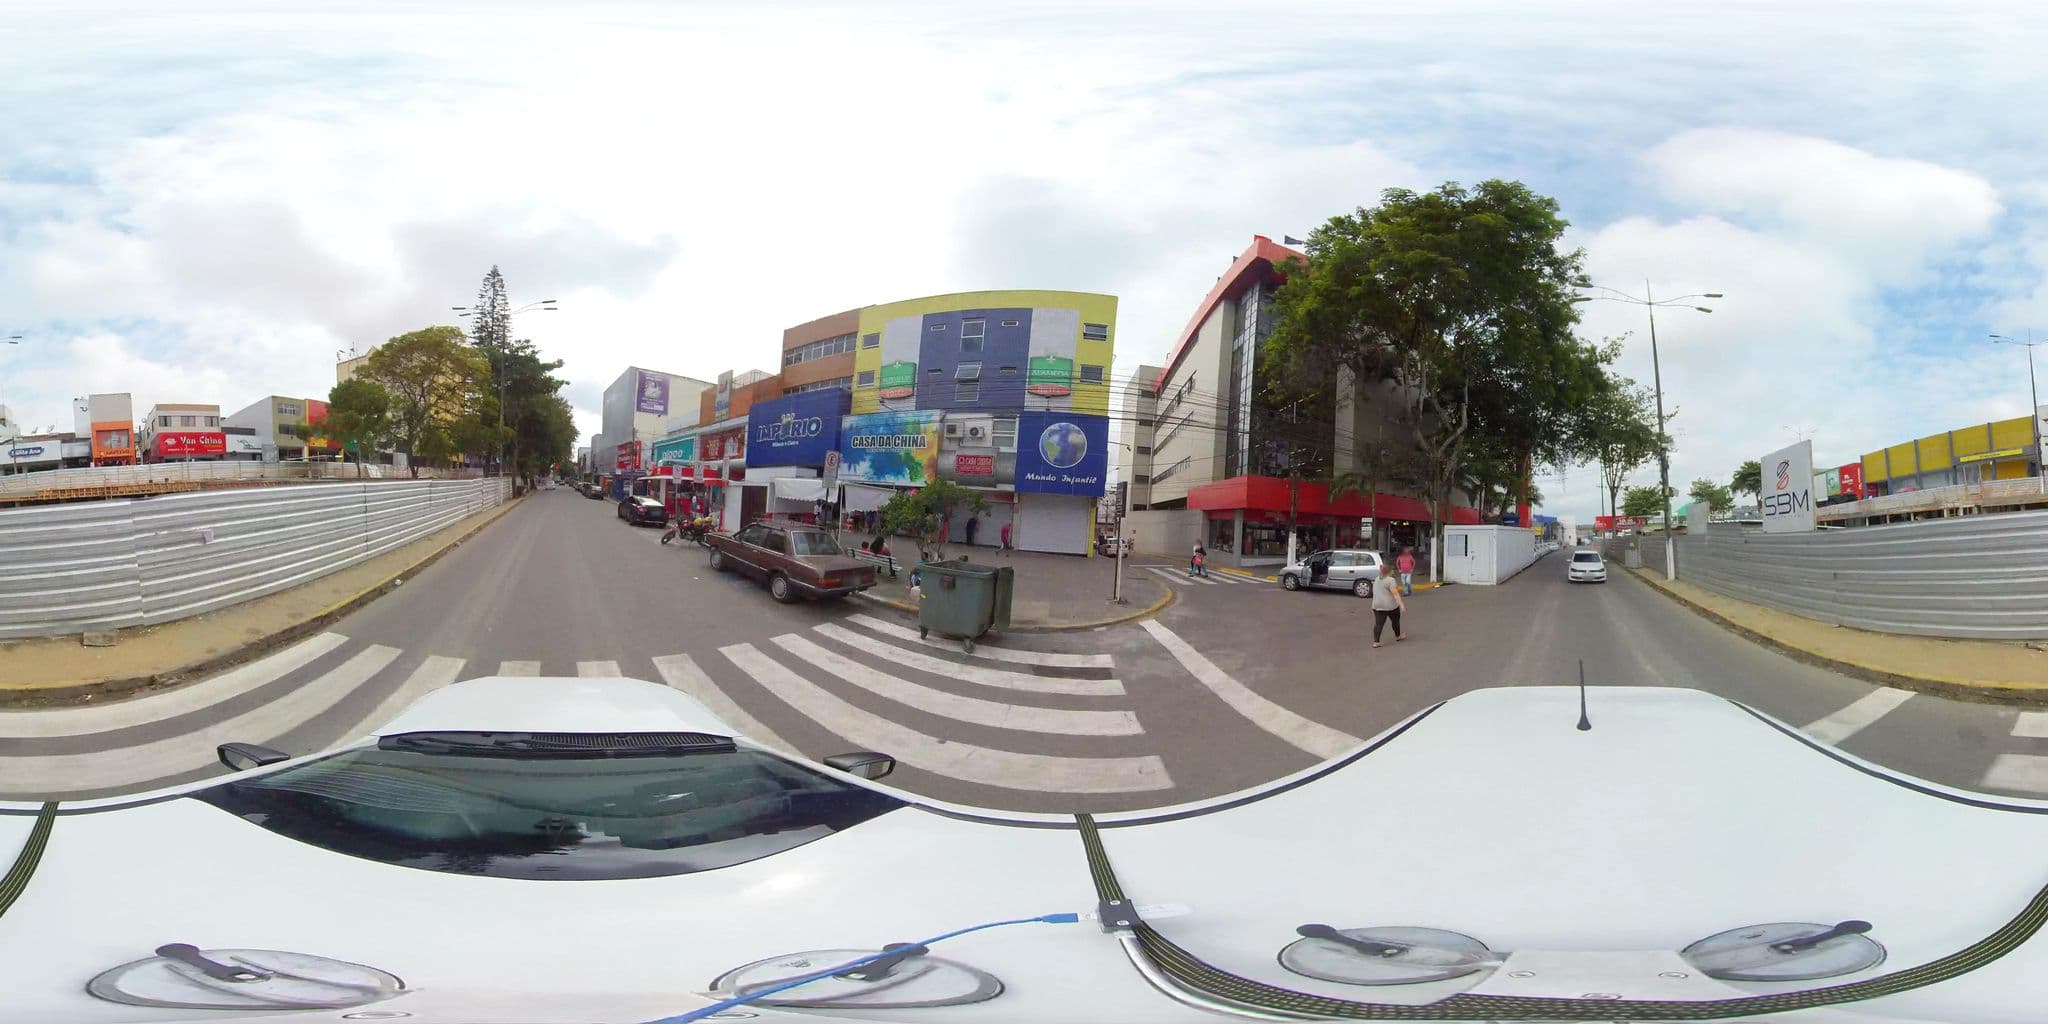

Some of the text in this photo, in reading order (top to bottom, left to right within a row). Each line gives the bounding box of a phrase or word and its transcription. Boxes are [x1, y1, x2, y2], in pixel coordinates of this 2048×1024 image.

[852, 435, 926, 448] CASA DA CHINA
[1025, 472, 1097, 485] Mundo Infantil
[1764, 489, 1809, 516] SBM
